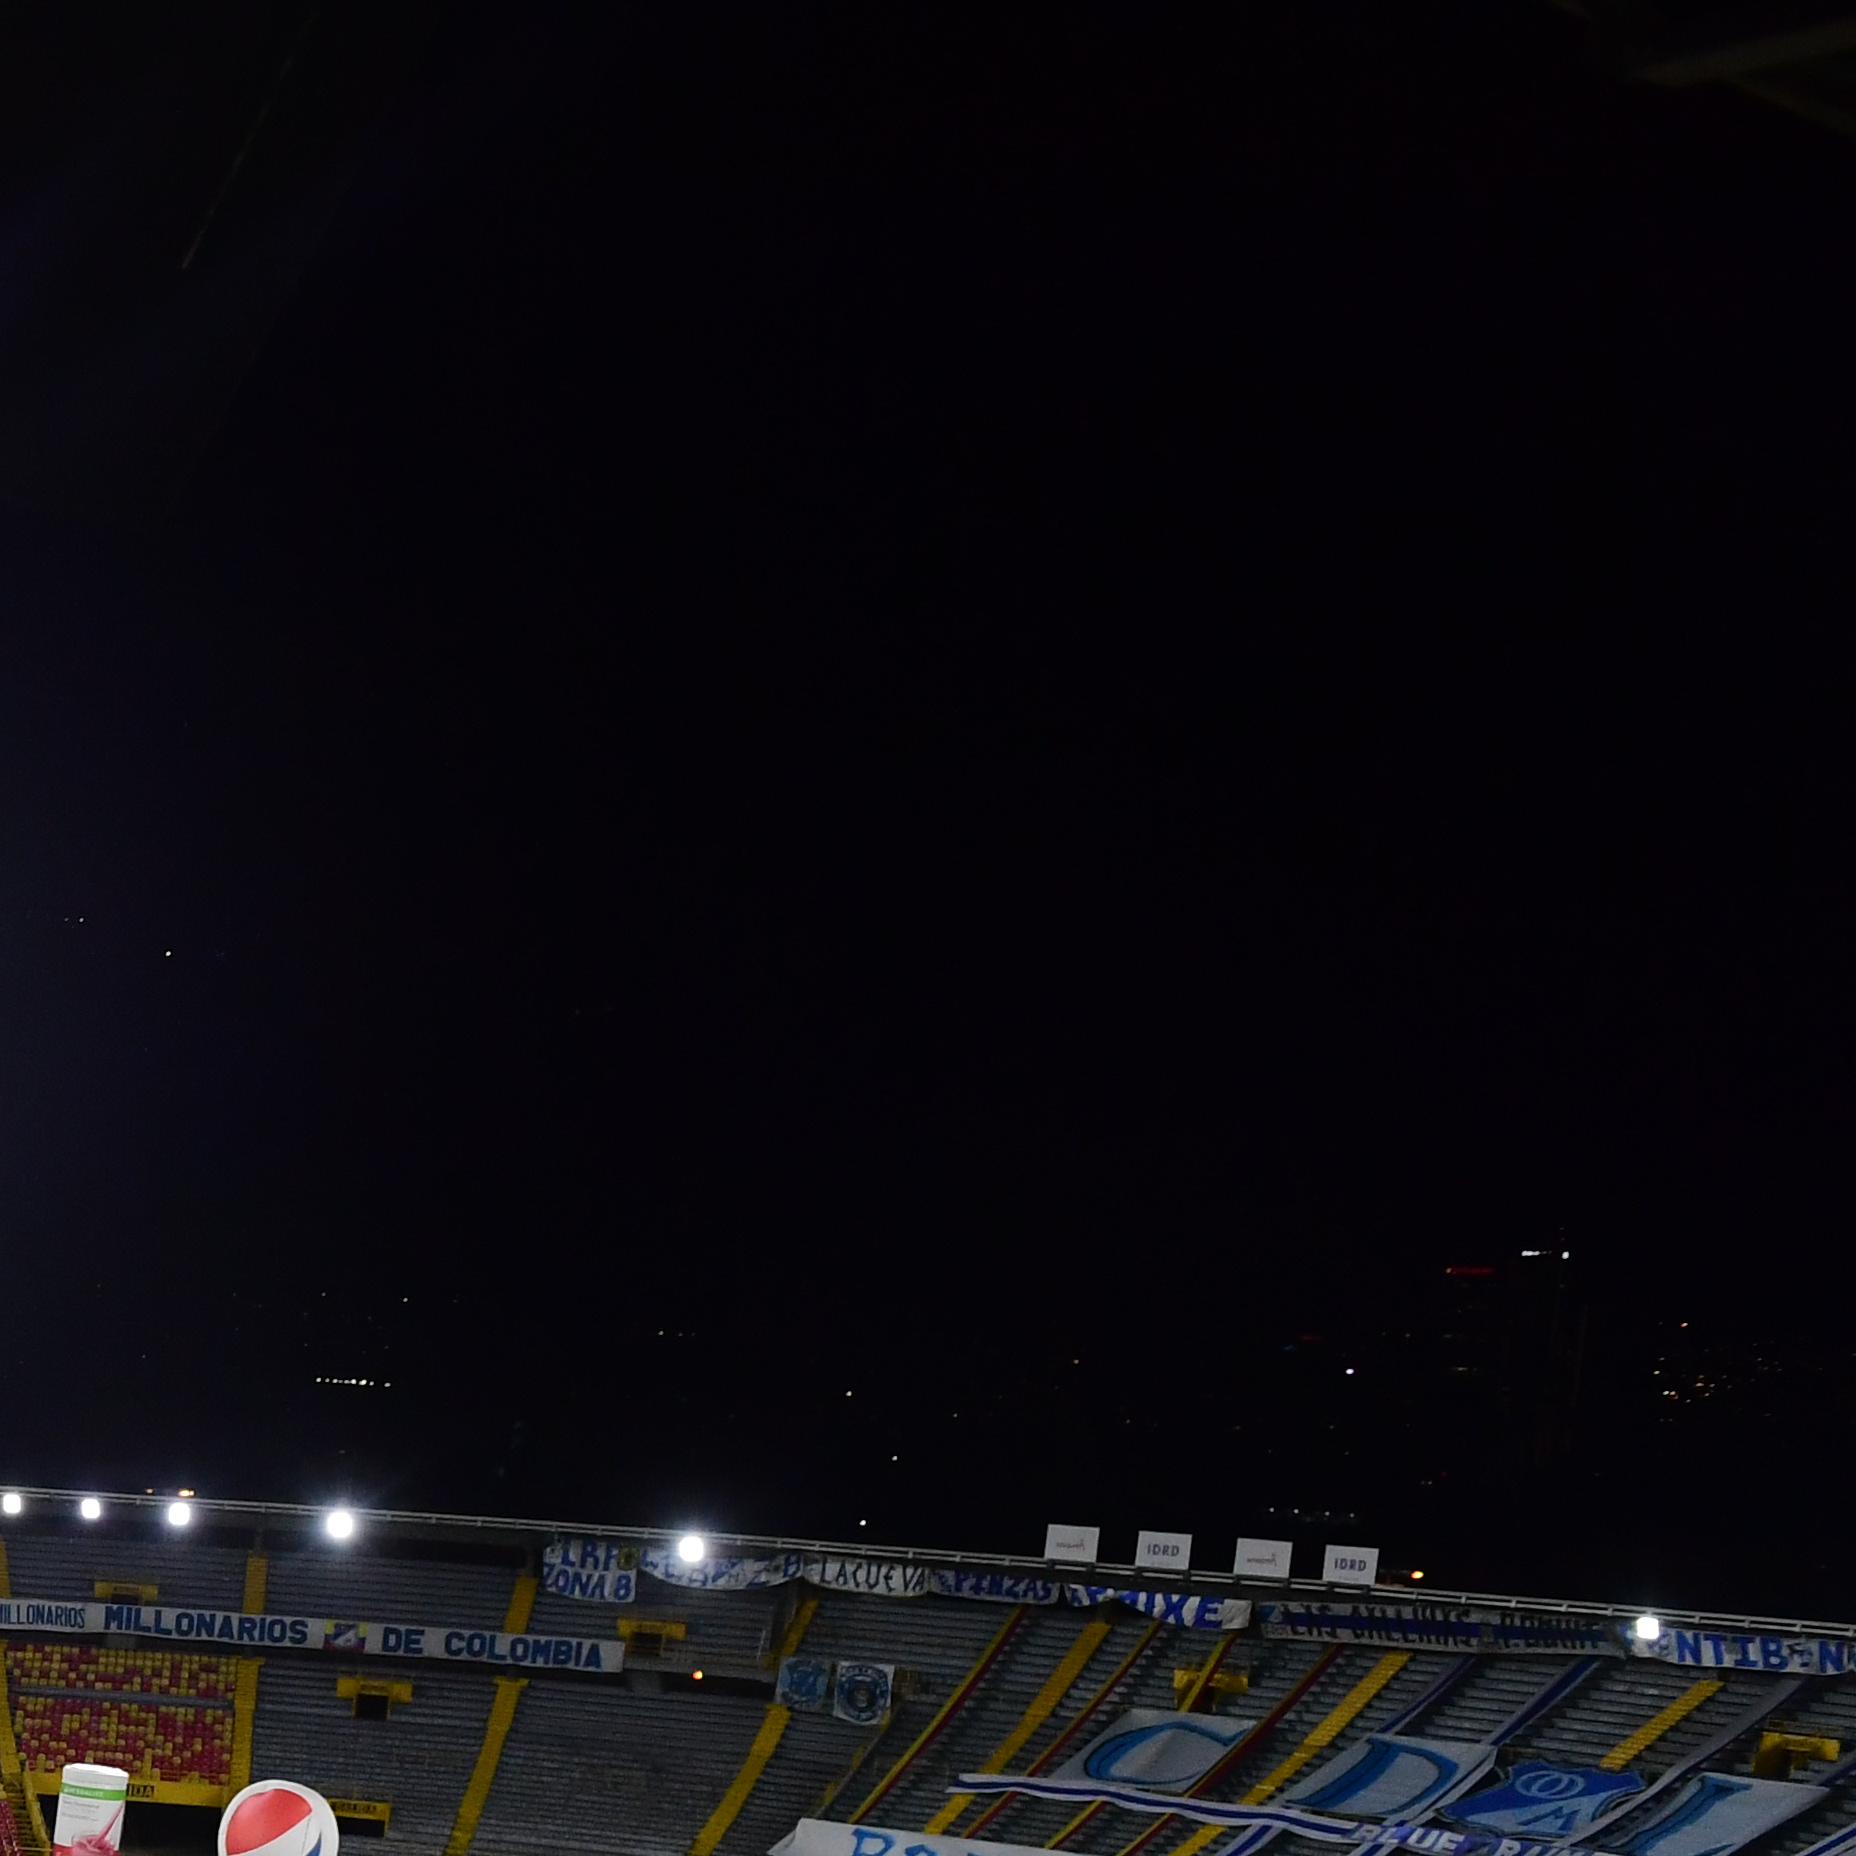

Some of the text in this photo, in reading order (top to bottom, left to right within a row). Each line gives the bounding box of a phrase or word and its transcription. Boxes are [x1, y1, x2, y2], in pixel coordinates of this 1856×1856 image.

[103, 1604, 604, 1670] MILLONARIOS DE COLOMBIA
